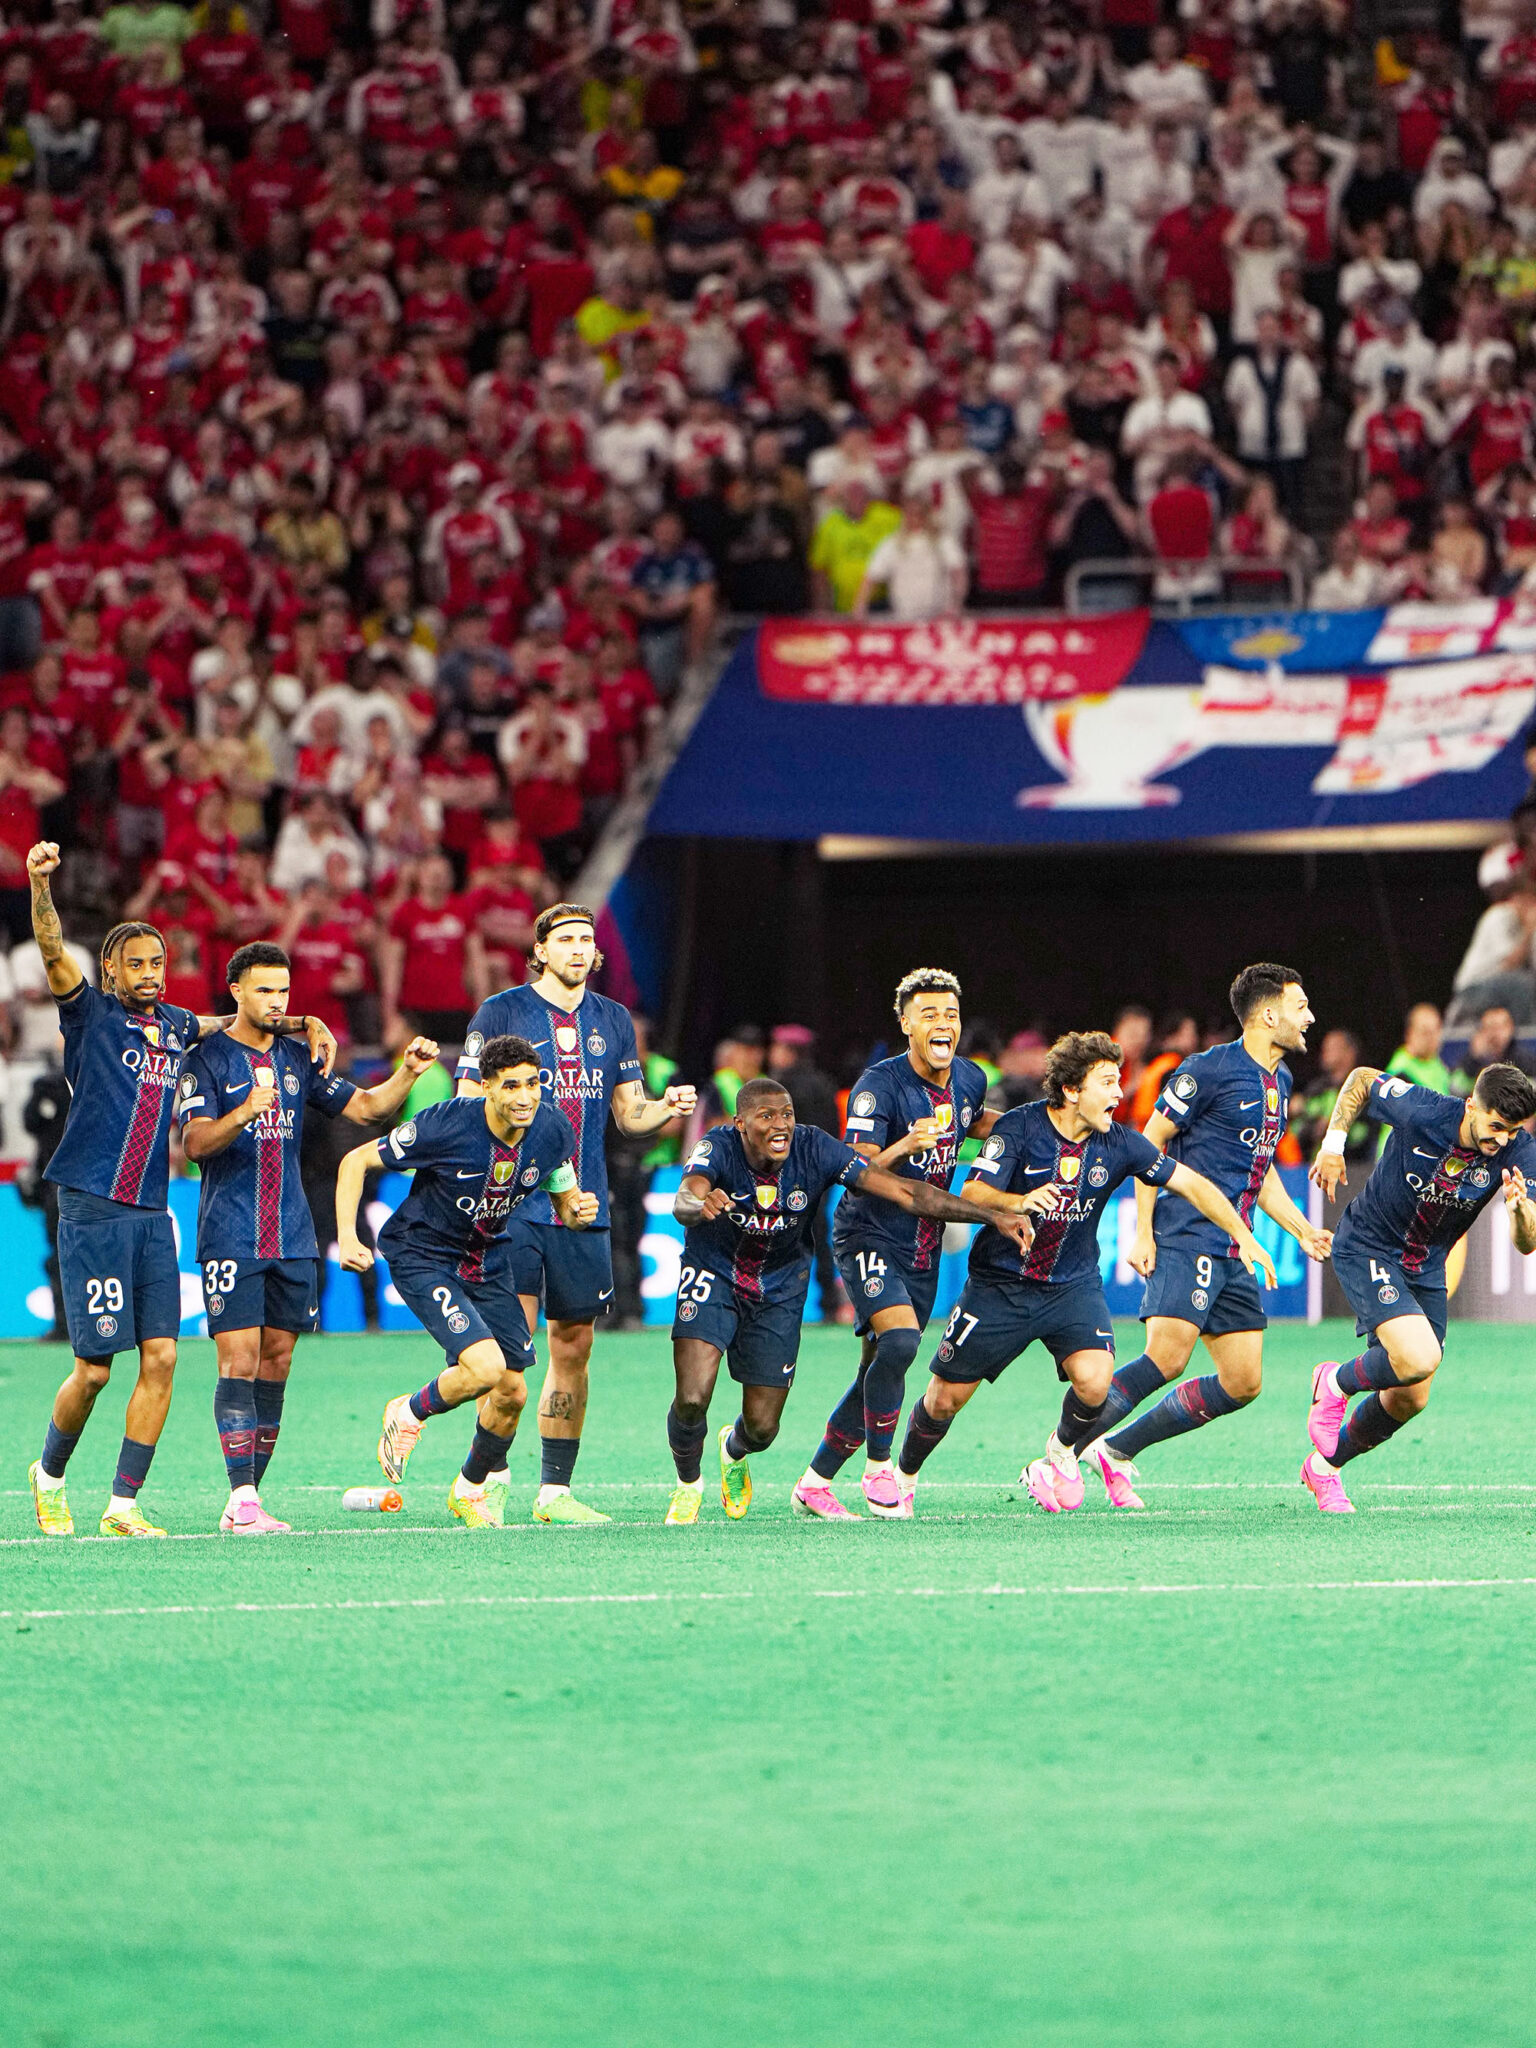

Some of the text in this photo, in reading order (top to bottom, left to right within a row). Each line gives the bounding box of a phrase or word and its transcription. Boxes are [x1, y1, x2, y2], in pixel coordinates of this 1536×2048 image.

[121, 1048, 182, 1078] QATAR
[135, 1070, 178, 1090] AIRWAYS
[538, 1068, 604, 1091] QATAR
[551, 1086, 604, 1100] AIRWAYS
[253, 1127, 294, 1140] AIRWAYS
[909, 1144, 956, 1170] QATA
[1057, 1195, 1097, 1213] TAR
[205, 1259, 238, 1294] 33
[855, 1251, 888, 1282] 14
[1196, 1255, 1212, 1288] 9
[1369, 1259, 1391, 1284] 4
[86, 1277, 124, 1315] 29
[677, 1266, 715, 1302] 25
[432, 1286, 460, 1318] 2
